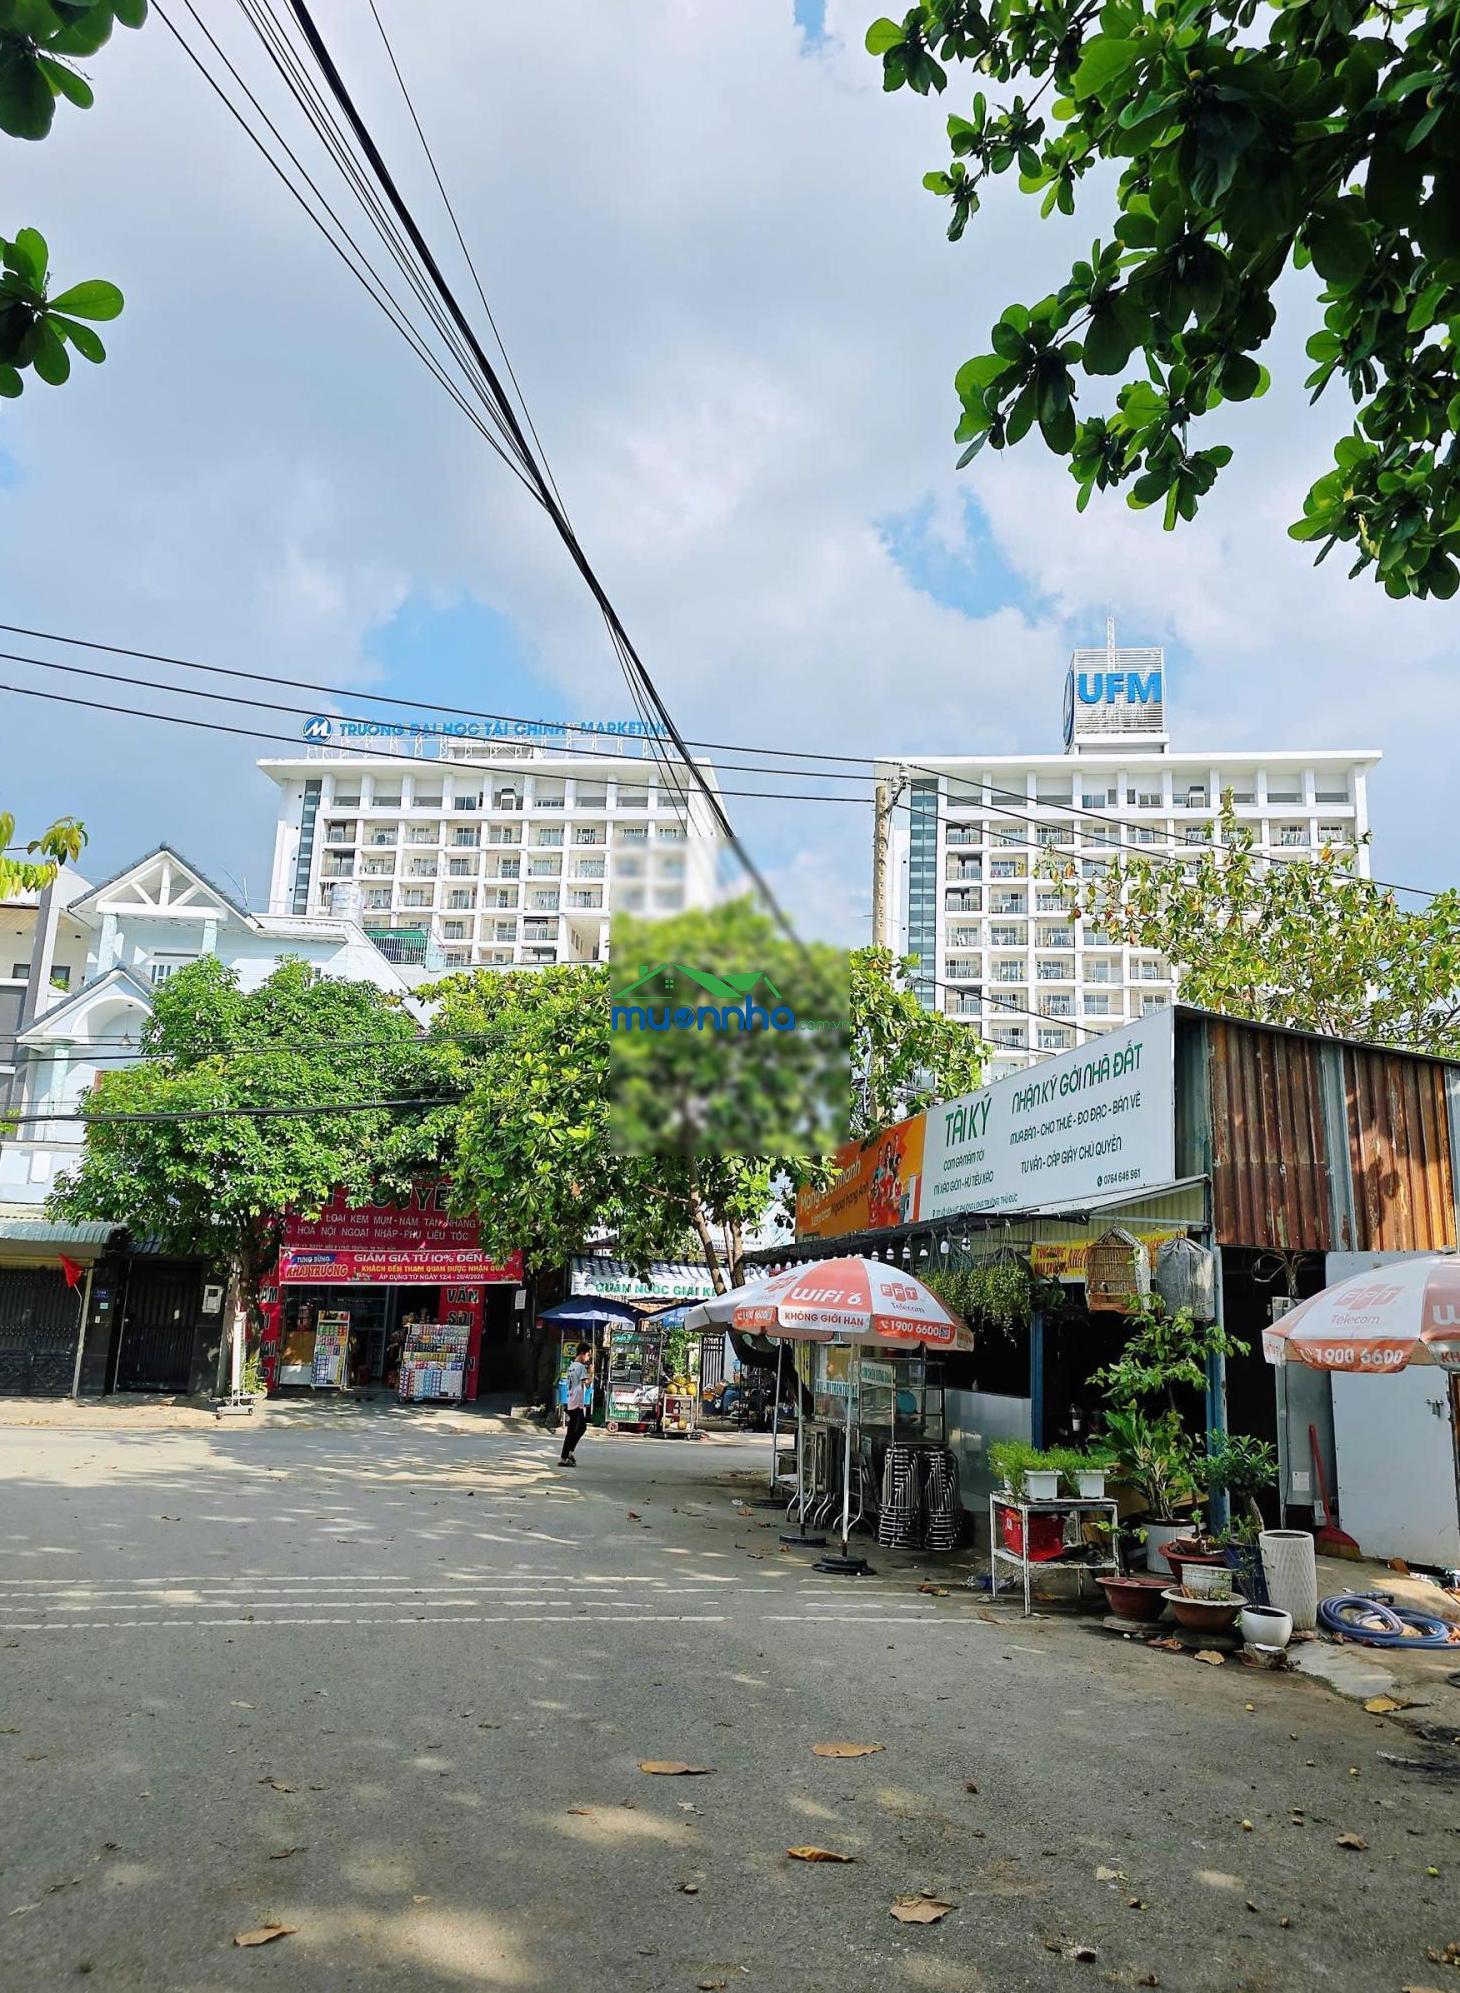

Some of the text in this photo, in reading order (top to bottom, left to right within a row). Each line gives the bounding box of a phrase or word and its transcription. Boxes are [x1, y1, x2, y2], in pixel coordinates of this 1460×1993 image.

[1079, 672, 1162, 704] UFM
[1012, 1084, 1040, 1114] NHẬN
[1042, 1074, 1058, 1104] KÝ
[1083, 1053, 1110, 1089] NHÀ
[1113, 1040, 1143, 1078] ĐẤT
[945, 1092, 992, 1147] TÀI KÝ
[1010, 1130, 1024, 1145] MUA
[1040, 1120, 1055, 1136] CHO
[1056, 1112, 1072, 1132] THUÊ
[1077, 1109, 1088, 1126] ĐO
[1091, 1104, 1107, 1123] ĐẠC
[1079, 1141, 1094, 1160] CHỦ
[350, 1214, 369, 1223] KEM
[297, 1226, 315, 1235] HOA
[342, 1228, 368, 1238] NGOẠI
[427, 1229, 445, 1240] LIỆU
[354, 1252, 385, 1262] GIẢM
[389, 1252, 411, 1262] GIÁ
[413, 1252, 429, 1262] TỪ
[432, 1254, 454, 1262] 10%
[457, 1251, 482, 1262] ĐẾN
[362, 1264, 385, 1272] KHÁCH
[880, 1283, 918, 1302] FPT
[891, 1302, 926, 1314] Telecom
[784, 1311, 864, 1328] KHÔNG GIỚI HẠN
[1332, 1313, 1380, 1326] Telecom
[890, 1320, 940, 1336] 1900 6600
[1314, 1348, 1354, 1364] 1900
